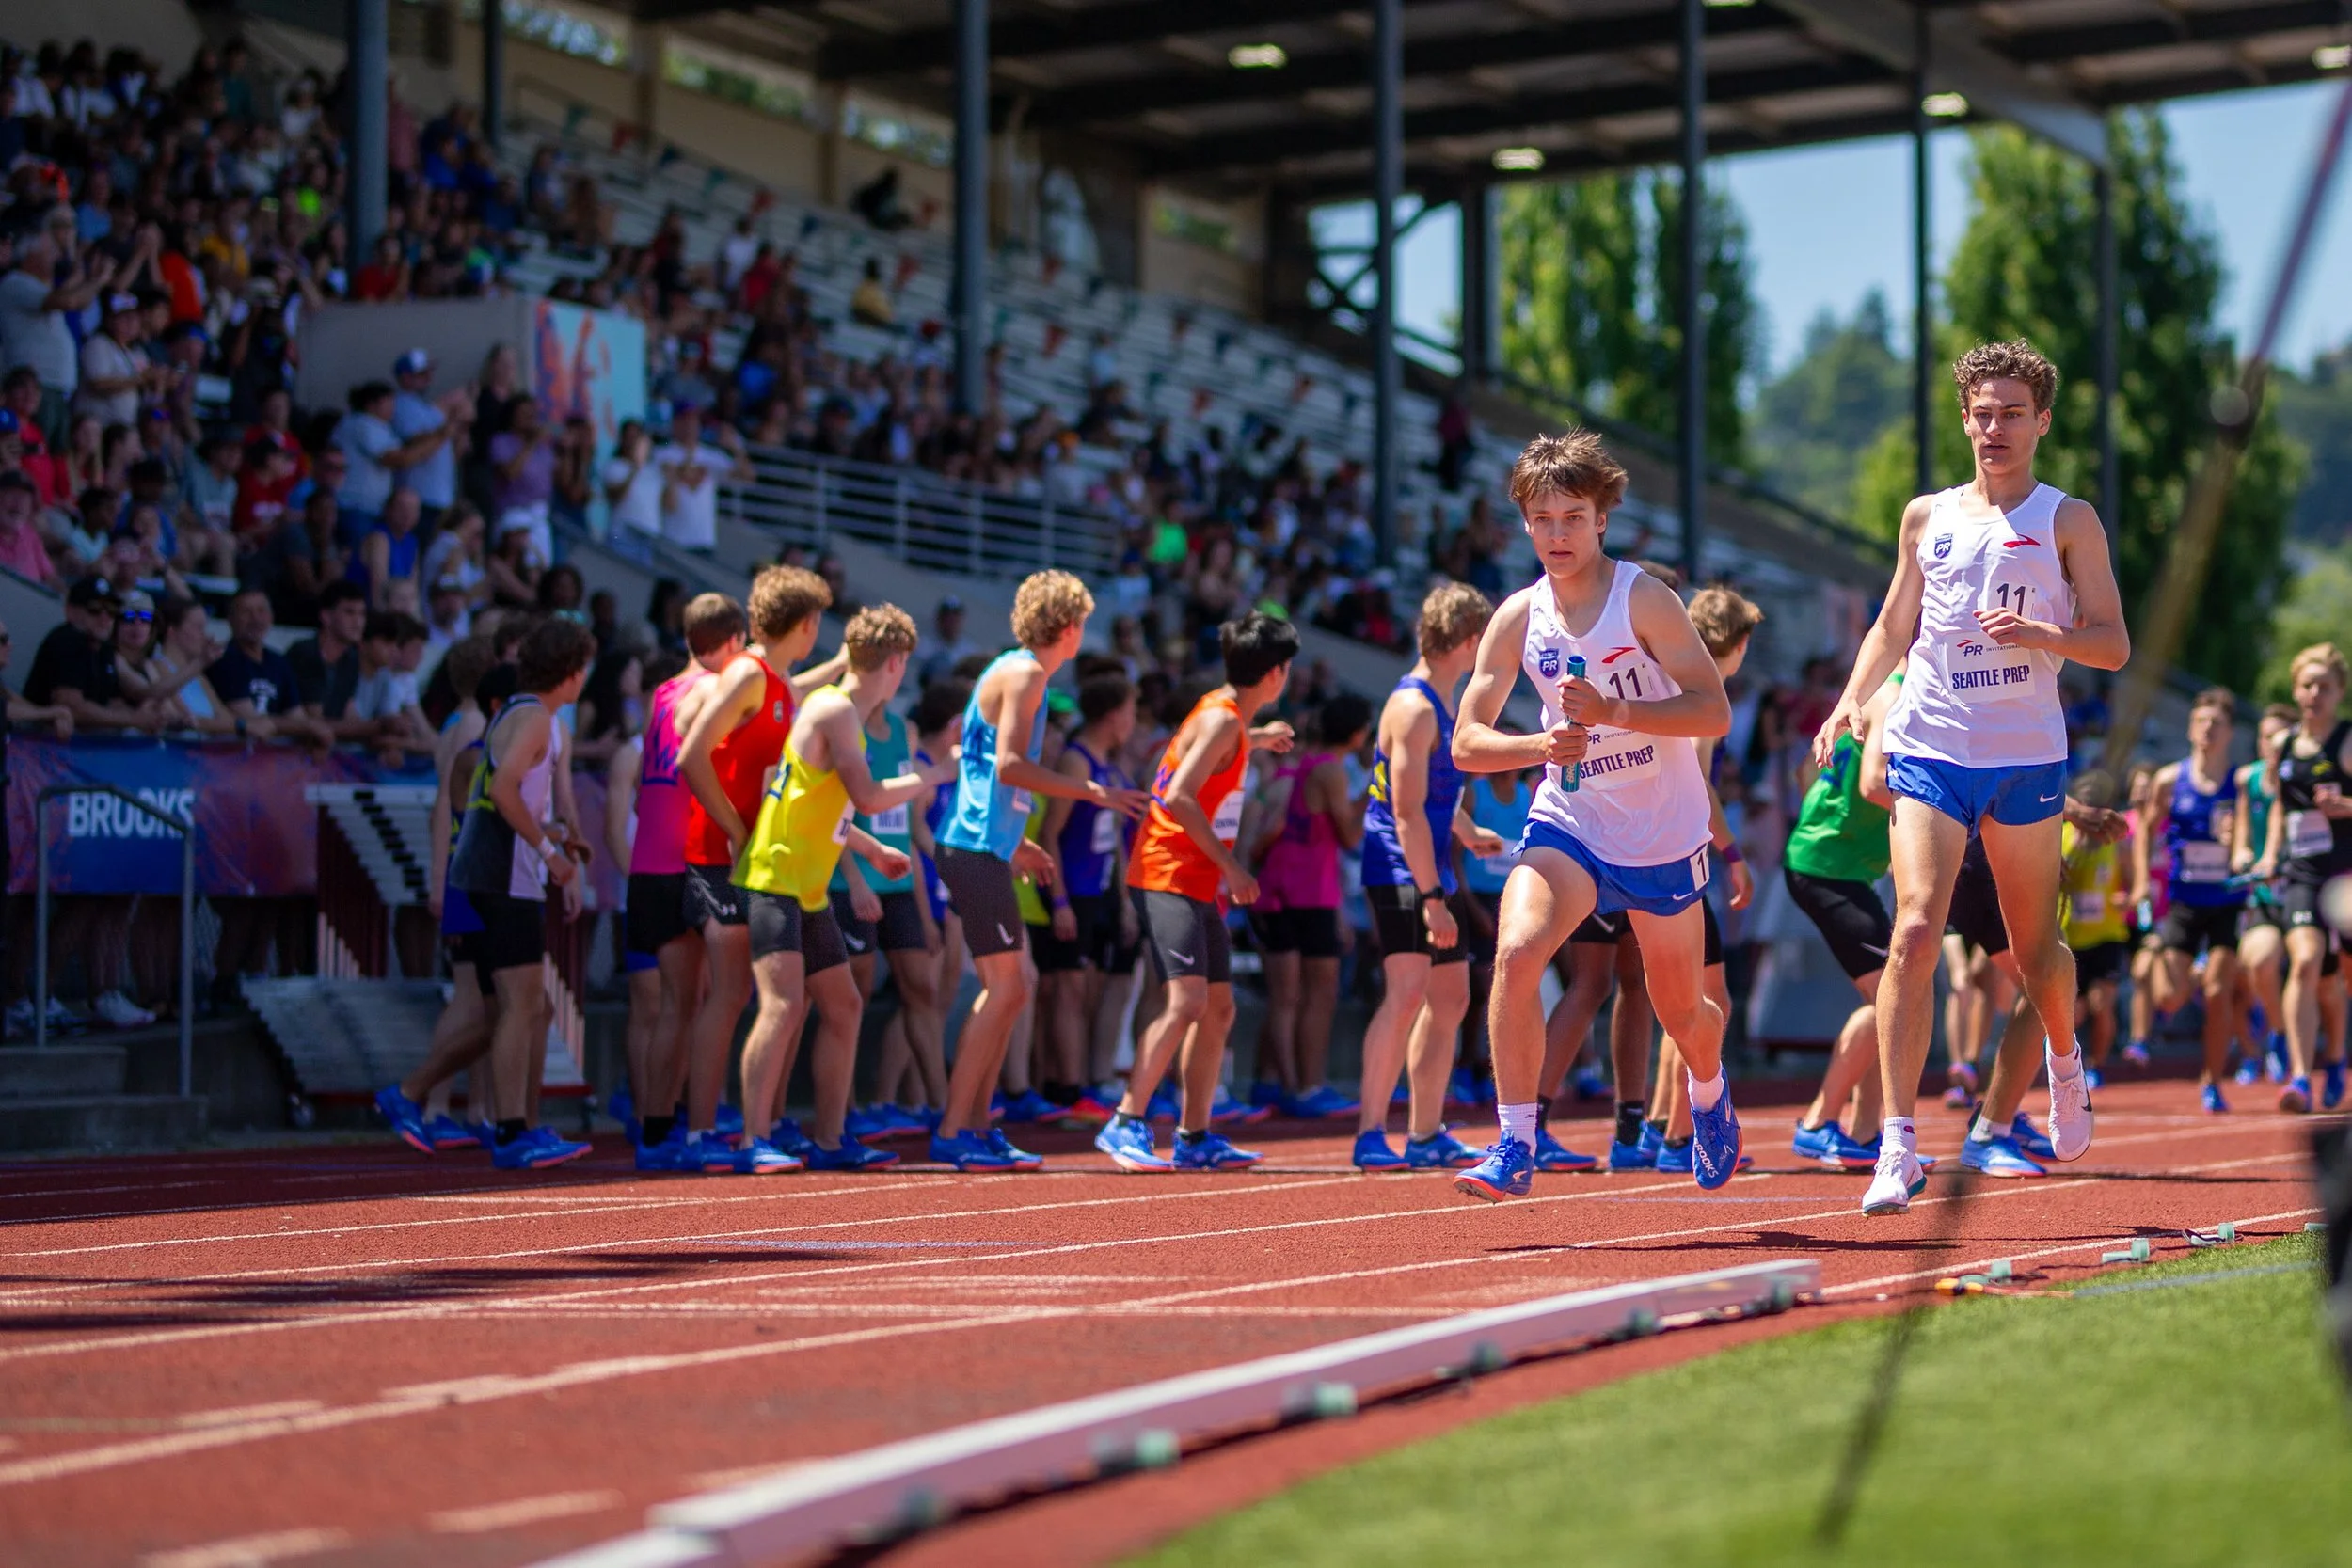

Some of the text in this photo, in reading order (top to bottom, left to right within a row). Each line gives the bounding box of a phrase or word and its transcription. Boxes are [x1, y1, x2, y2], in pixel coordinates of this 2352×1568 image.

[1935, 542, 1951, 554] PR
[1996, 582, 2026, 617] 11
[1542, 660, 1557, 671] PR
[1963, 644, 1983, 657] PR
[1608, 667, 1643, 700] 11
[1951, 665, 2030, 689] SEATTLE PREP
[1580, 745, 1654, 780] SEATTLE PREP
[68, 788, 195, 837] BROOKS
[1693, 1141, 1720, 1179] ROOKS
